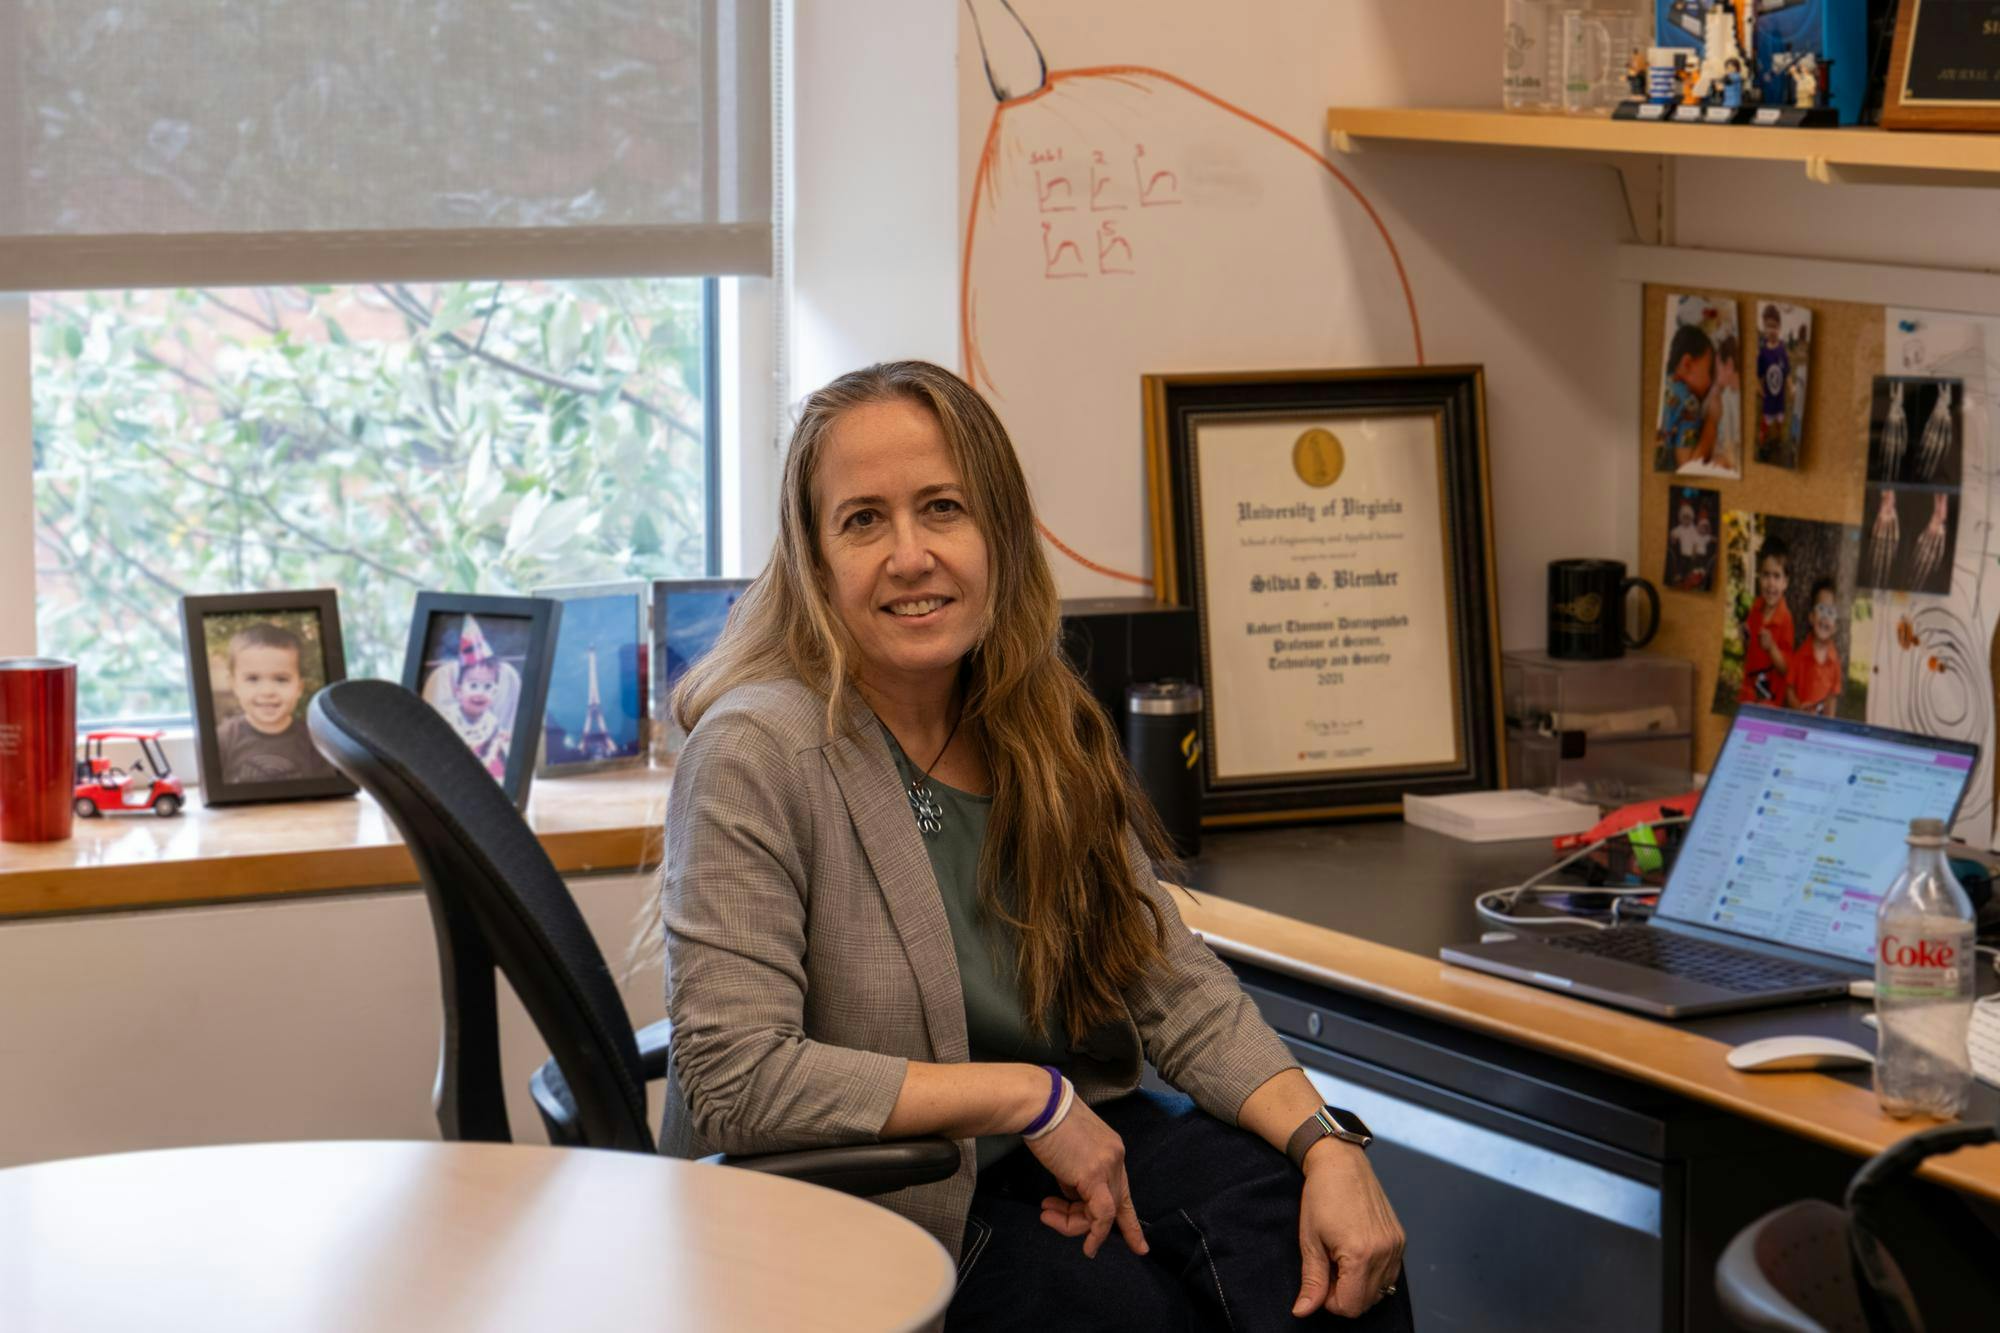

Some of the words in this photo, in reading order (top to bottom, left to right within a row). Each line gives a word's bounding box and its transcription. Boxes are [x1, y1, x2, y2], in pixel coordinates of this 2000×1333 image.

[1237, 501, 1316, 524] University
[1321, 499, 1337, 518] of
[1341, 497, 1403, 521] Virginia
[1250, 573, 1300, 593] Silvia
[1306, 571, 1328, 590] S.
[1333, 568, 1398, 590] Blemker
[1246, 622, 1282, 635] Robert
[1338, 615, 1409, 630] Distinguished
[1273, 637, 1325, 653] Professor
[1328, 637, 1339, 648] of
[1268, 655, 1327, 670] Technology
[1330, 655, 1348, 666] and
[1352, 652, 1391, 666] Society
[1881, 934, 1954, 969] Coke
